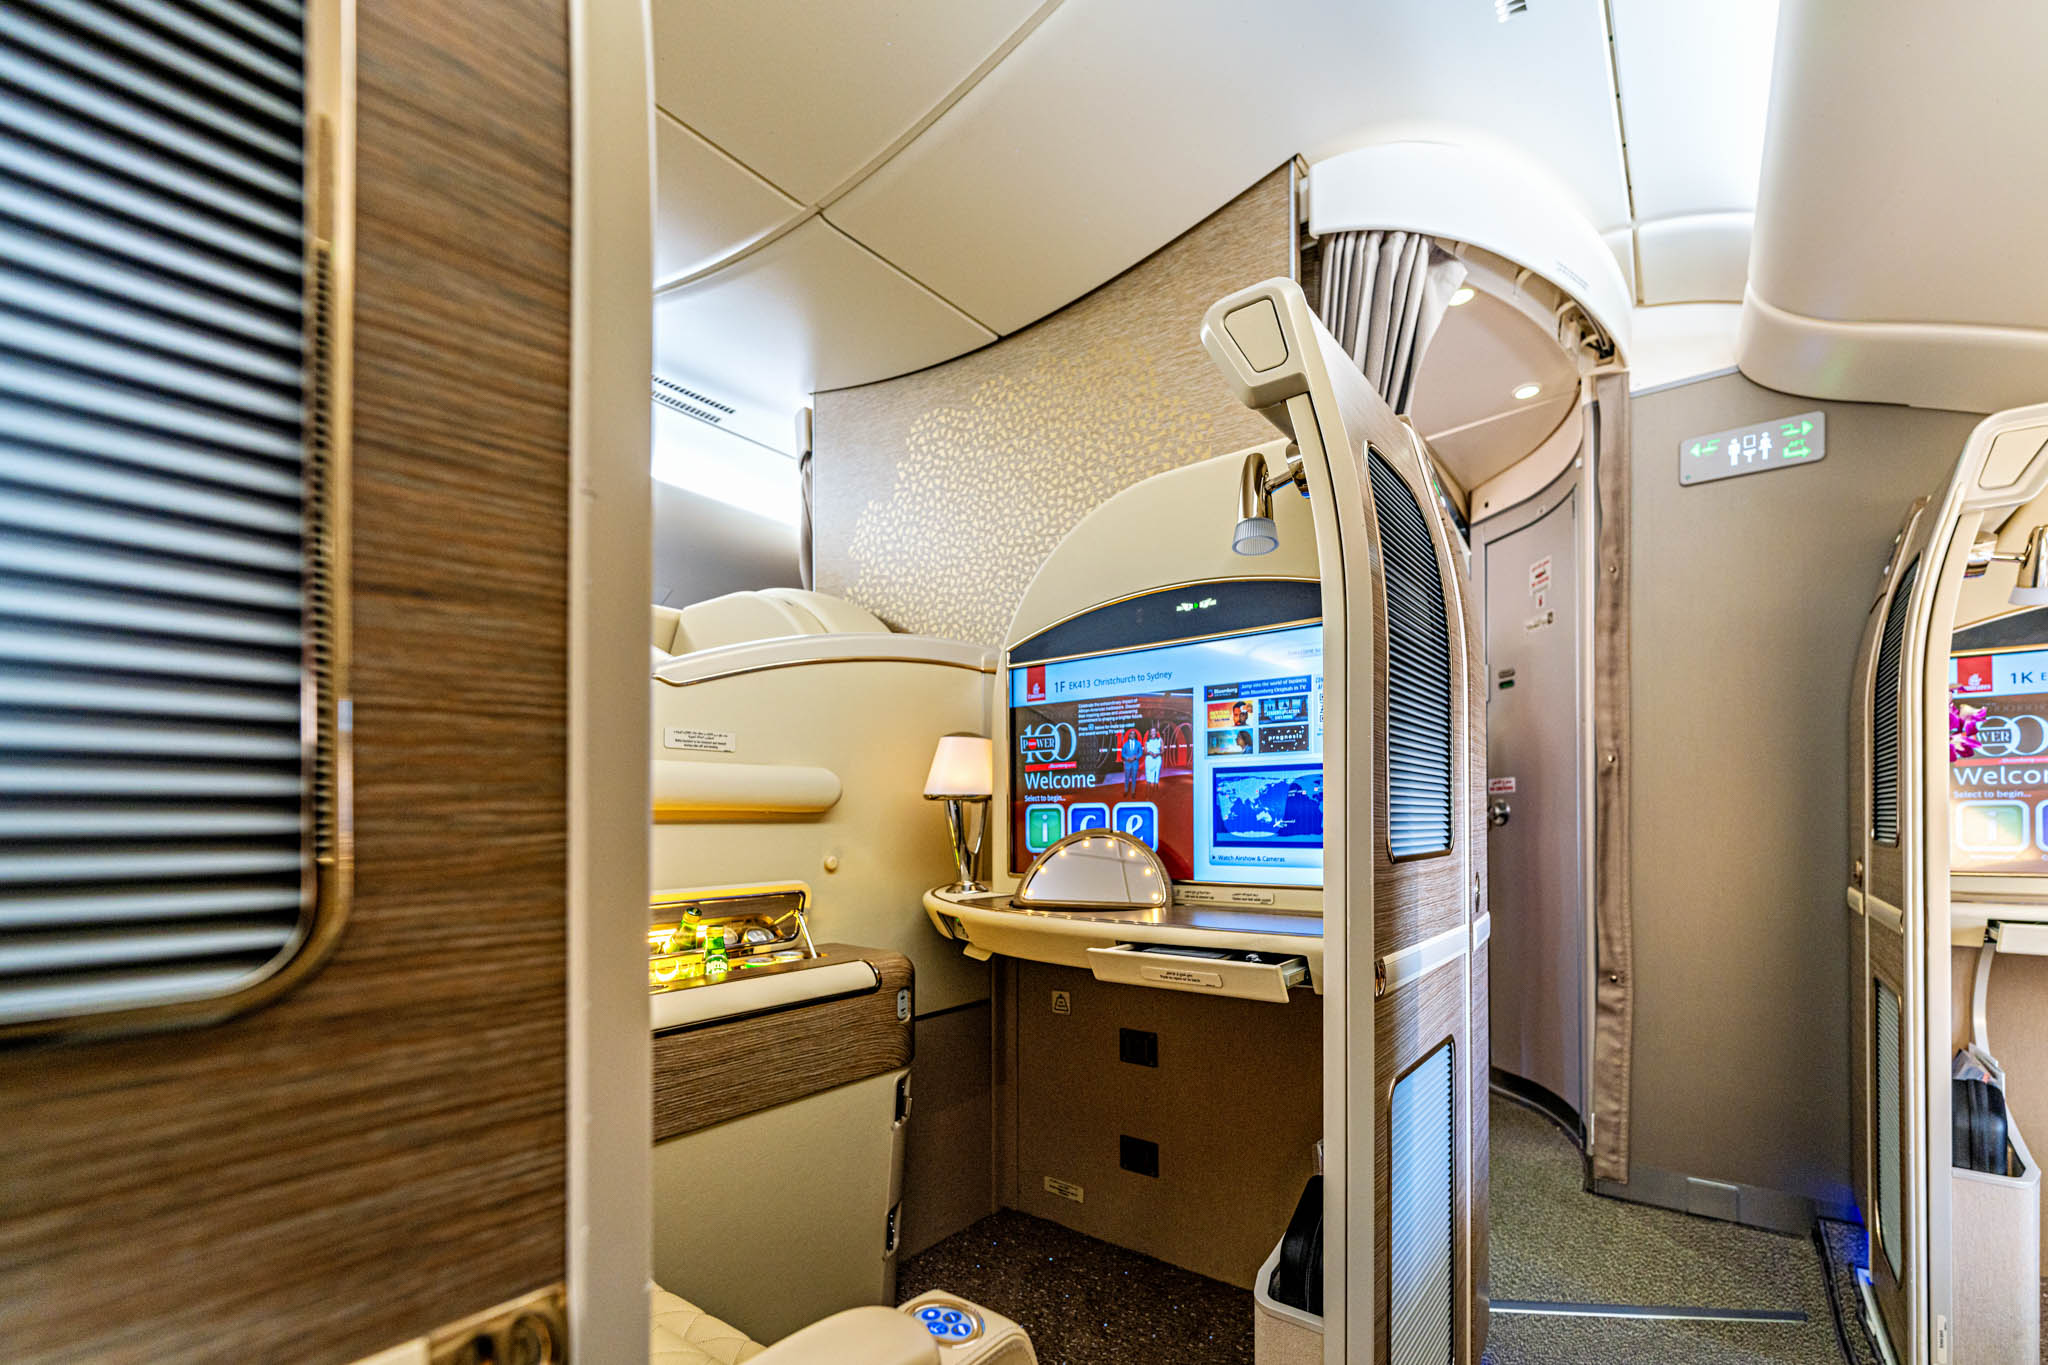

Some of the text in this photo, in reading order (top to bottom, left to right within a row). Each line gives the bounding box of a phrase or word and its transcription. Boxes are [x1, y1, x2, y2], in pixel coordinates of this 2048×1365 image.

[1055, 671, 1173, 693] 1F EK413 Christchurch to Sydney
[2011, 671, 2033, 685] 1K
[1976, 731, 2012, 743] WER
[1024, 770, 1096, 790] Welcome
[1953, 791, 1982, 799] Select
